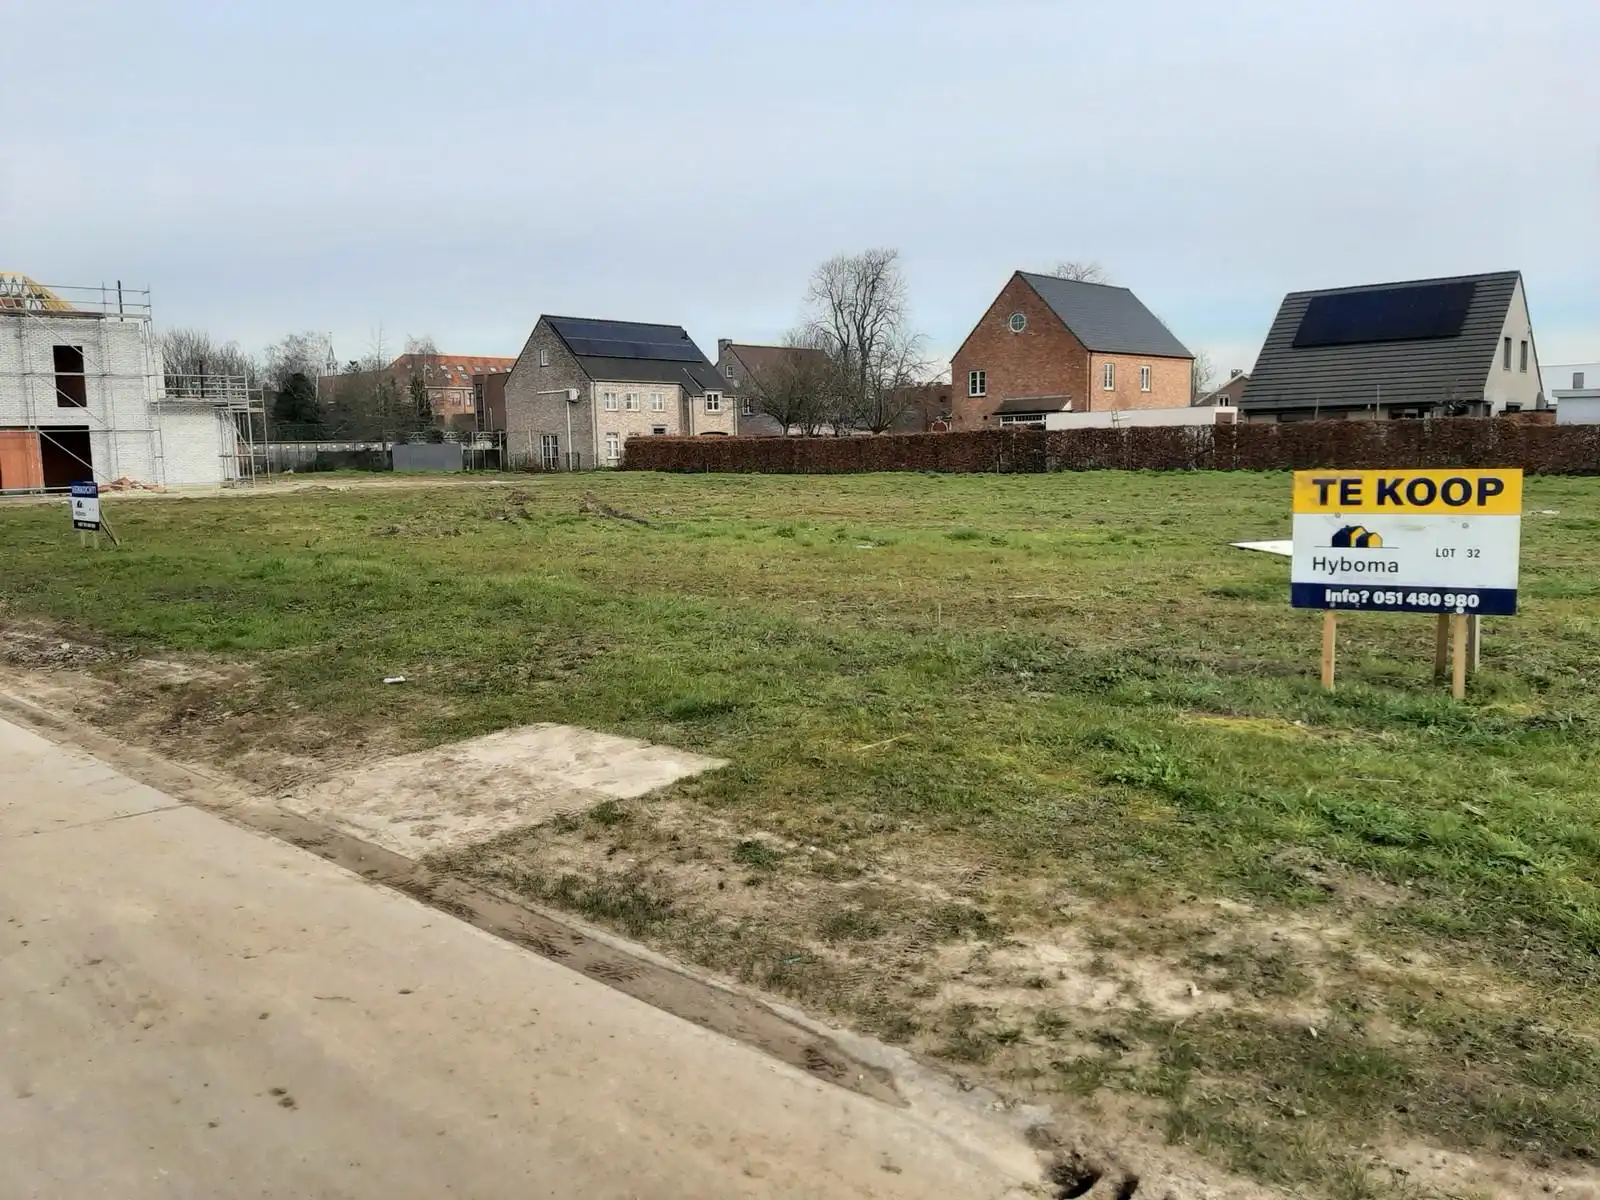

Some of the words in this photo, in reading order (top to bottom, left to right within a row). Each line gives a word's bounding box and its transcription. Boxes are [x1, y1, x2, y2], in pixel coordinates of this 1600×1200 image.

[1312, 478, 1362, 506] TE
[1377, 477, 1505, 507] KOOP
[1435, 548, 1456, 558] LOT
[1466, 548, 1481, 559] 32
[1312, 556, 1399, 575] Hyboma
[1325, 588, 1370, 604] Info?
[1372, 592, 1403, 606] 051
[1406, 593, 1441, 607] 480
[1443, 593, 1480, 609] 980
